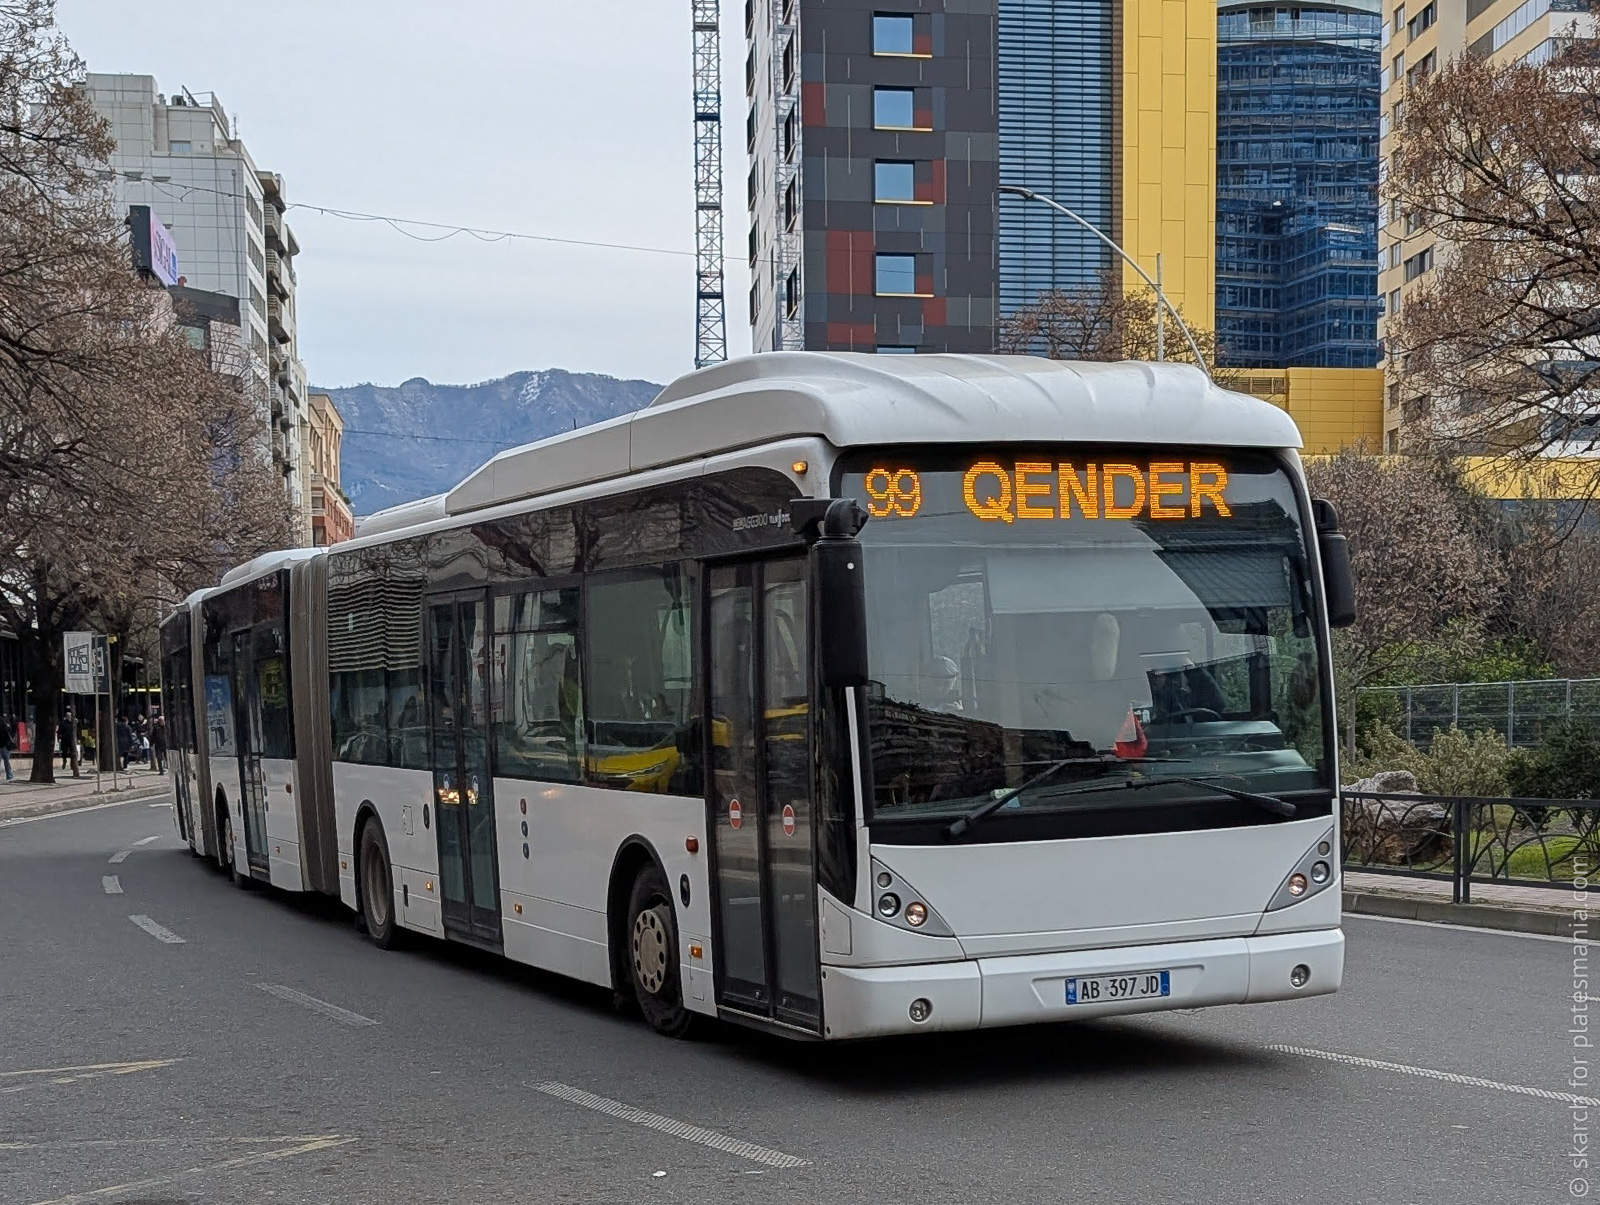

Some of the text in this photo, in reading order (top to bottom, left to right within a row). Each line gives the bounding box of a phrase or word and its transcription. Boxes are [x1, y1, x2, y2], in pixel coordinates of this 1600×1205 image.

[865, 462, 1232, 522] 99 QENDER
[1081, 981, 1100, 1000] AB
[1109, 977, 1137, 997] 397
[1141, 976, 1159, 994] JD
